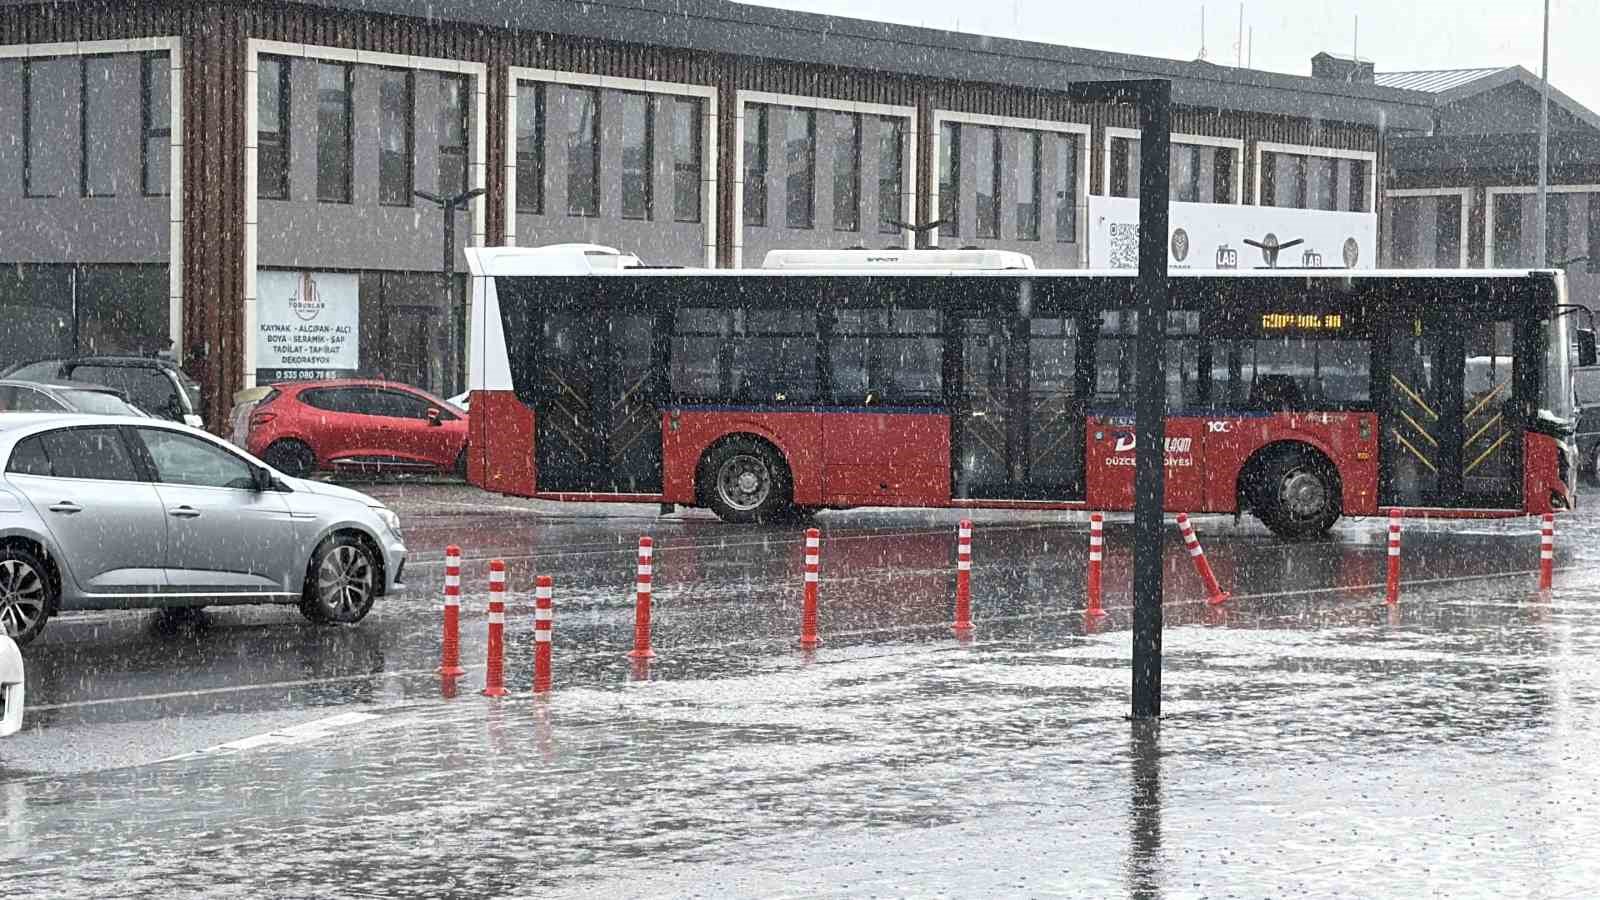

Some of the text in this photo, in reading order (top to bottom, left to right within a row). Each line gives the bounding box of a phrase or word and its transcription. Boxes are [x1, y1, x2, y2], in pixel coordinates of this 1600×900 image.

[260, 324, 290, 332] KAYNAK
[267, 335, 287, 343] BOYA
[281, 356, 331, 364] DEKORASYON
